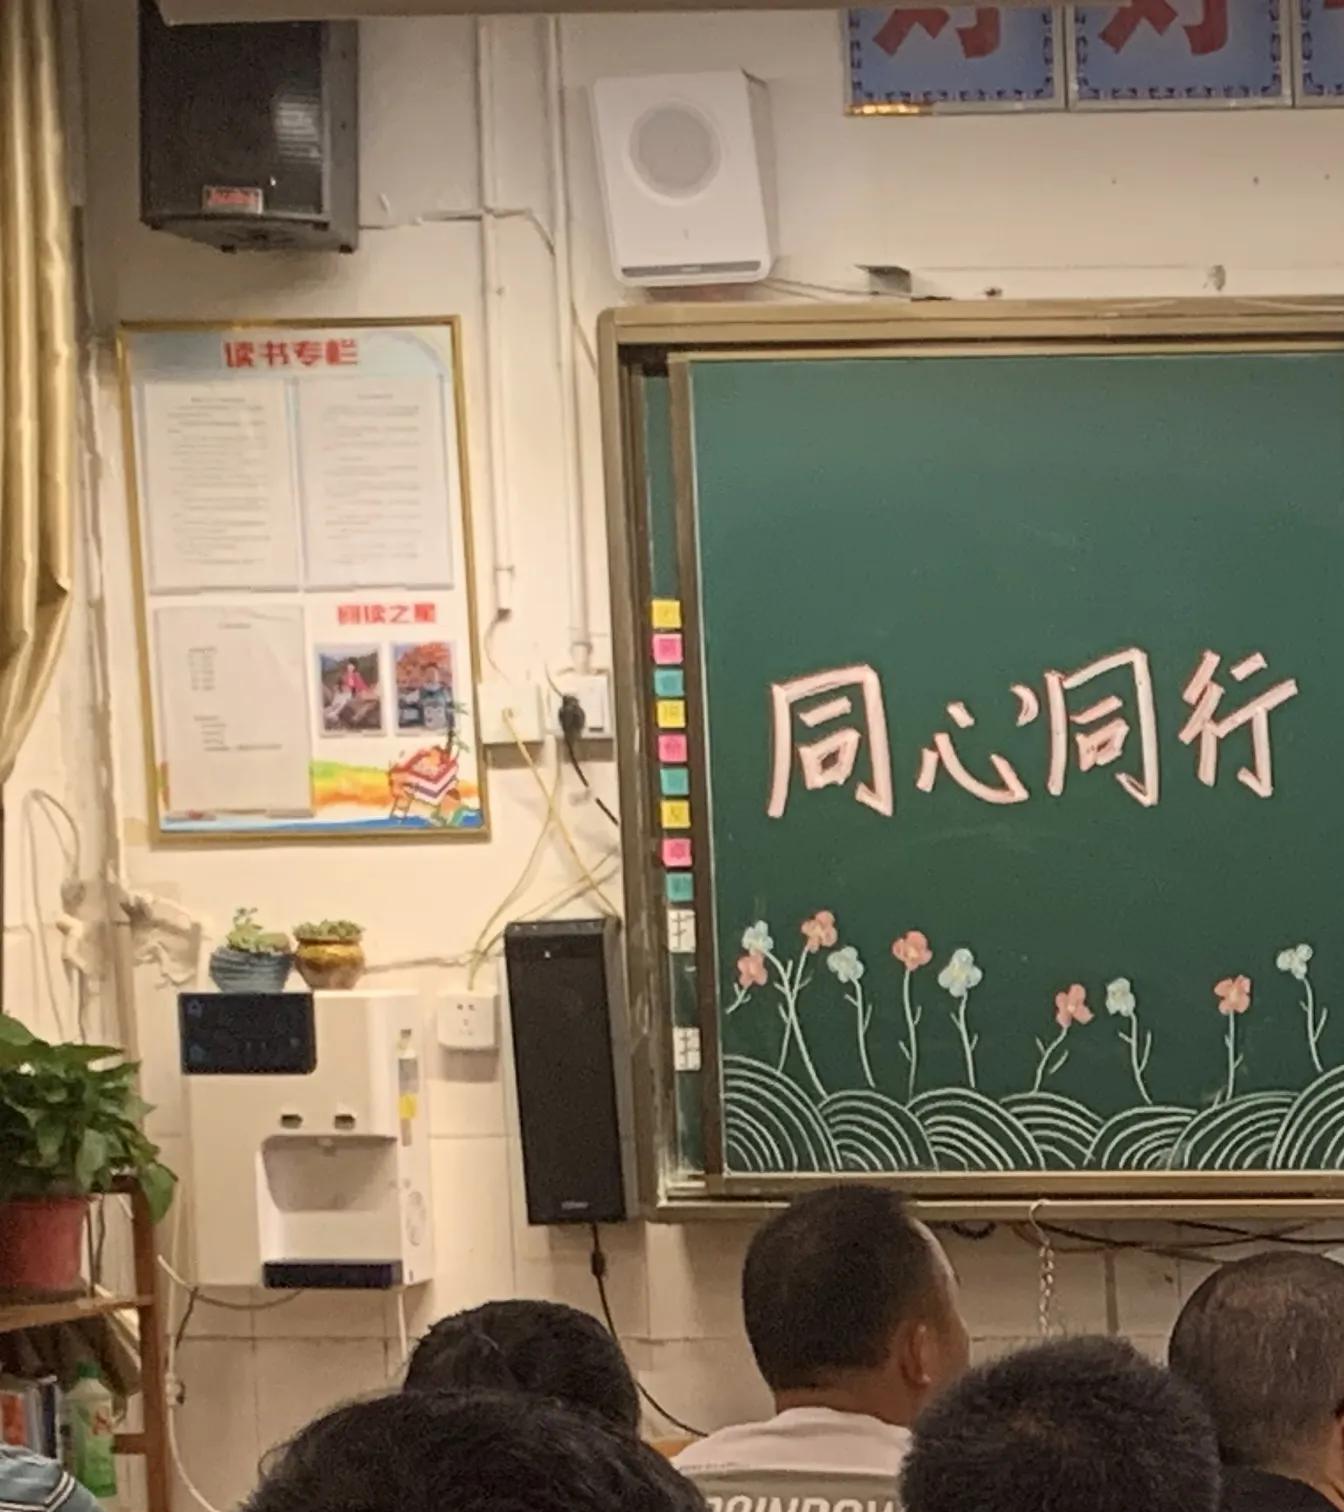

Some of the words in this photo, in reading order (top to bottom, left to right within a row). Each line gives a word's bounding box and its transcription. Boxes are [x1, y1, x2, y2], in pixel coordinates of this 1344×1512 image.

[222, 337, 359, 369] 读书专栏
[766, 647, 1298, 818] 同心同行
